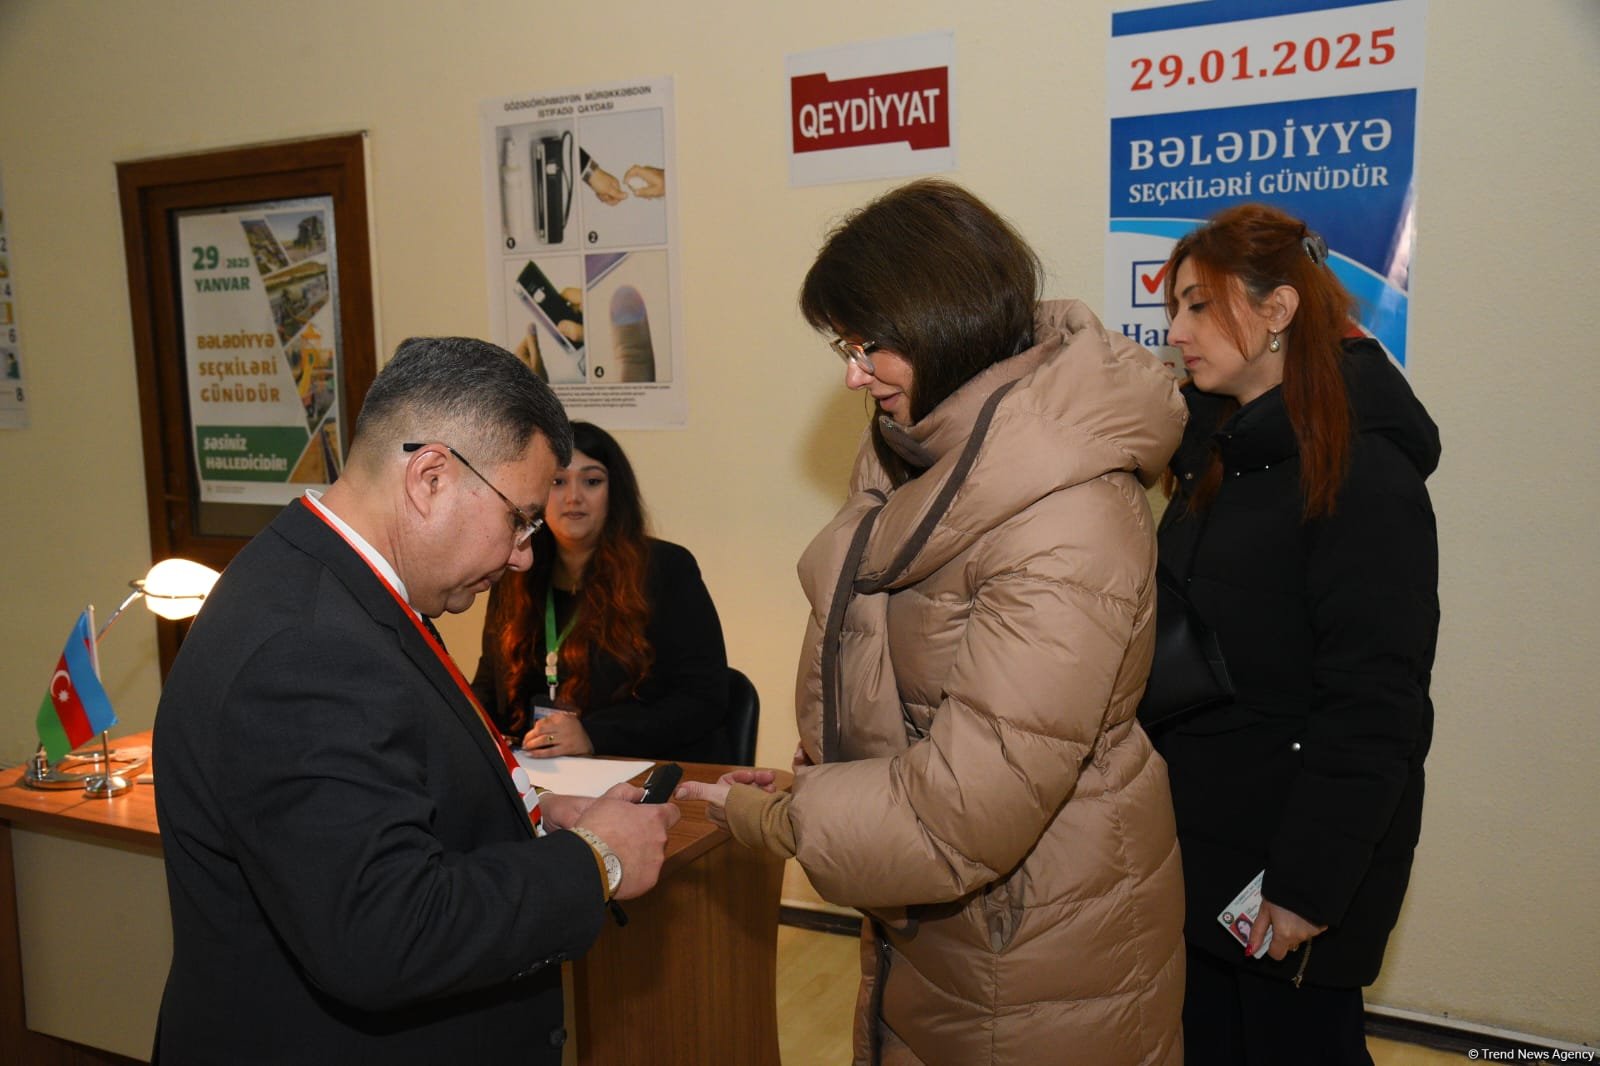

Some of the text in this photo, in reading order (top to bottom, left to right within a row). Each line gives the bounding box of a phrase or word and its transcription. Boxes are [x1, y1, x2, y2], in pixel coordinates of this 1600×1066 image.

[1130, 27, 1395, 91] 29.01.2025
[800, 88, 940, 139] QEYDİYYAT
[1129, 118, 1392, 170] BƏLƏDİYYƏ
[1129, 163, 1389, 206] SEÇKİLƏRİ GÜNÜDÜR
[191, 245, 250, 270] 29 2025
[194, 276, 250, 293] YANVAR
[197, 329, 275, 349] BƏLƏDİYYƏ
[198, 356, 278, 381] SEÇKİLƏRİ
[200, 383, 281, 403] GÜNÜDÜR
[203, 433, 248, 450] SƏSİNİZ
[206, 454, 288, 472] HƏLLEDİCİDİR!
